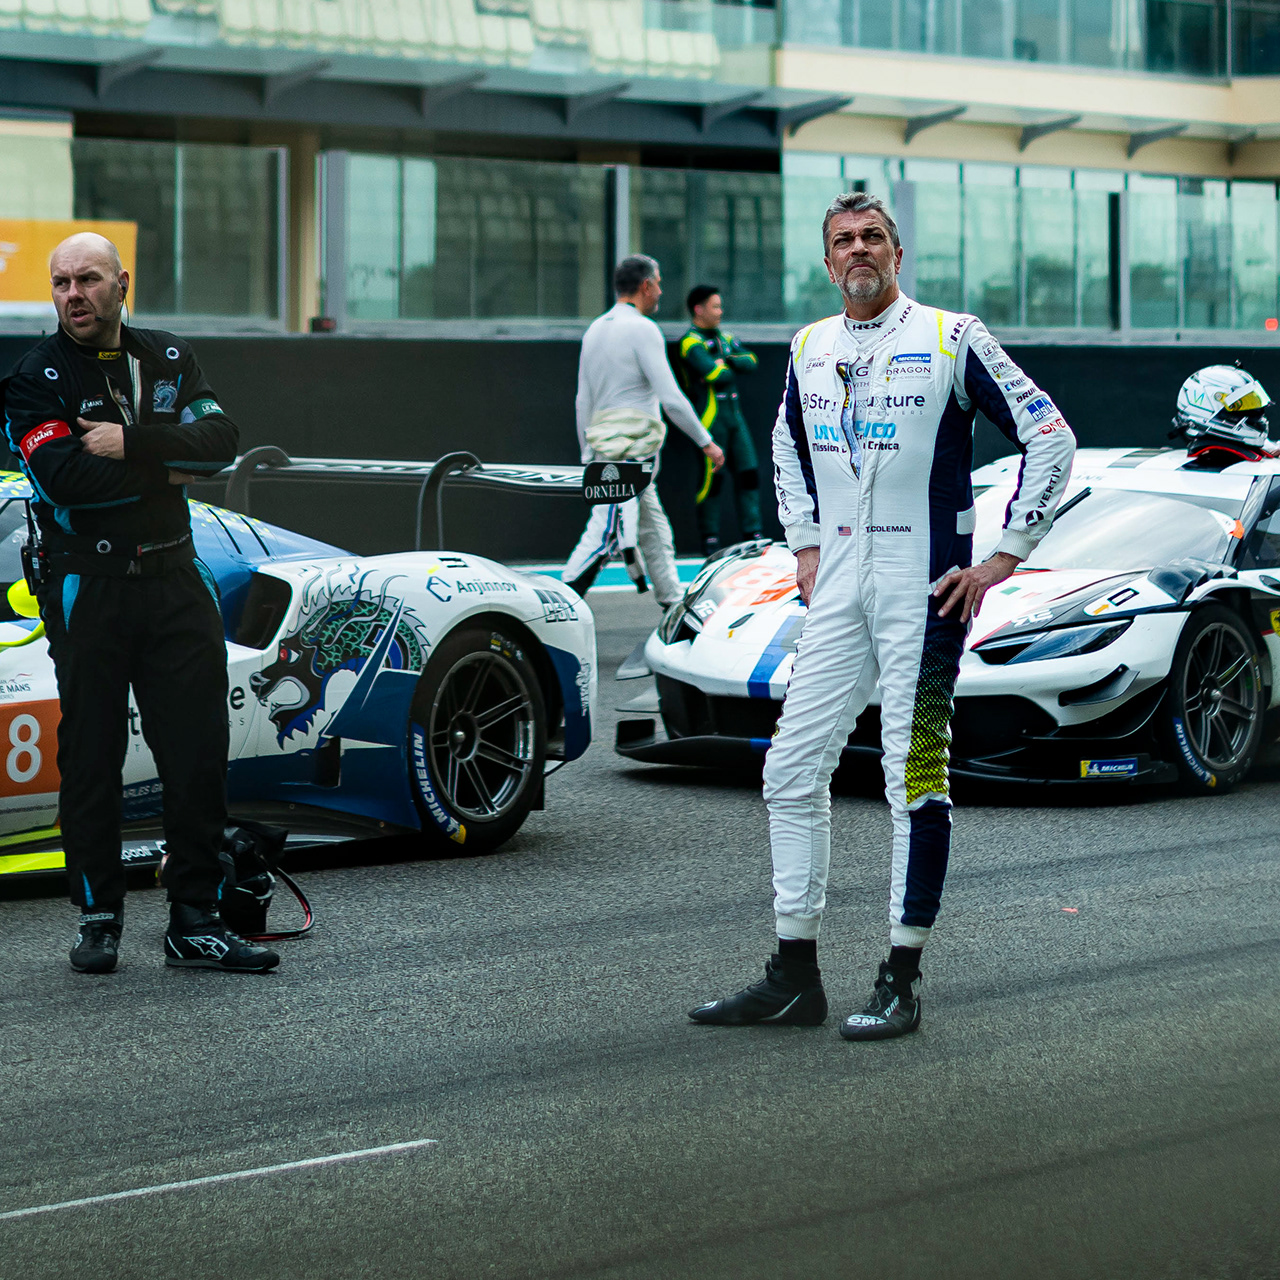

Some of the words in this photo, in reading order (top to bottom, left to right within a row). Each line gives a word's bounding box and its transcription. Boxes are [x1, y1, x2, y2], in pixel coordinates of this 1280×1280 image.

[852, 321, 885, 331] HRX
[897, 355, 932, 363] MICHELIN
[886, 367, 932, 376] DRAGON
[584, 483, 637, 500] ORNELLA
[1037, 464, 1063, 509] VERTIV
[865, 525, 913, 534] T.COLEMAN
[6, 683, 32, 695] MANS
[6, 713, 42, 783] 8
[1175, 723, 1204, 778] MICHELIN
[413, 733, 448, 824] MICHELIN
